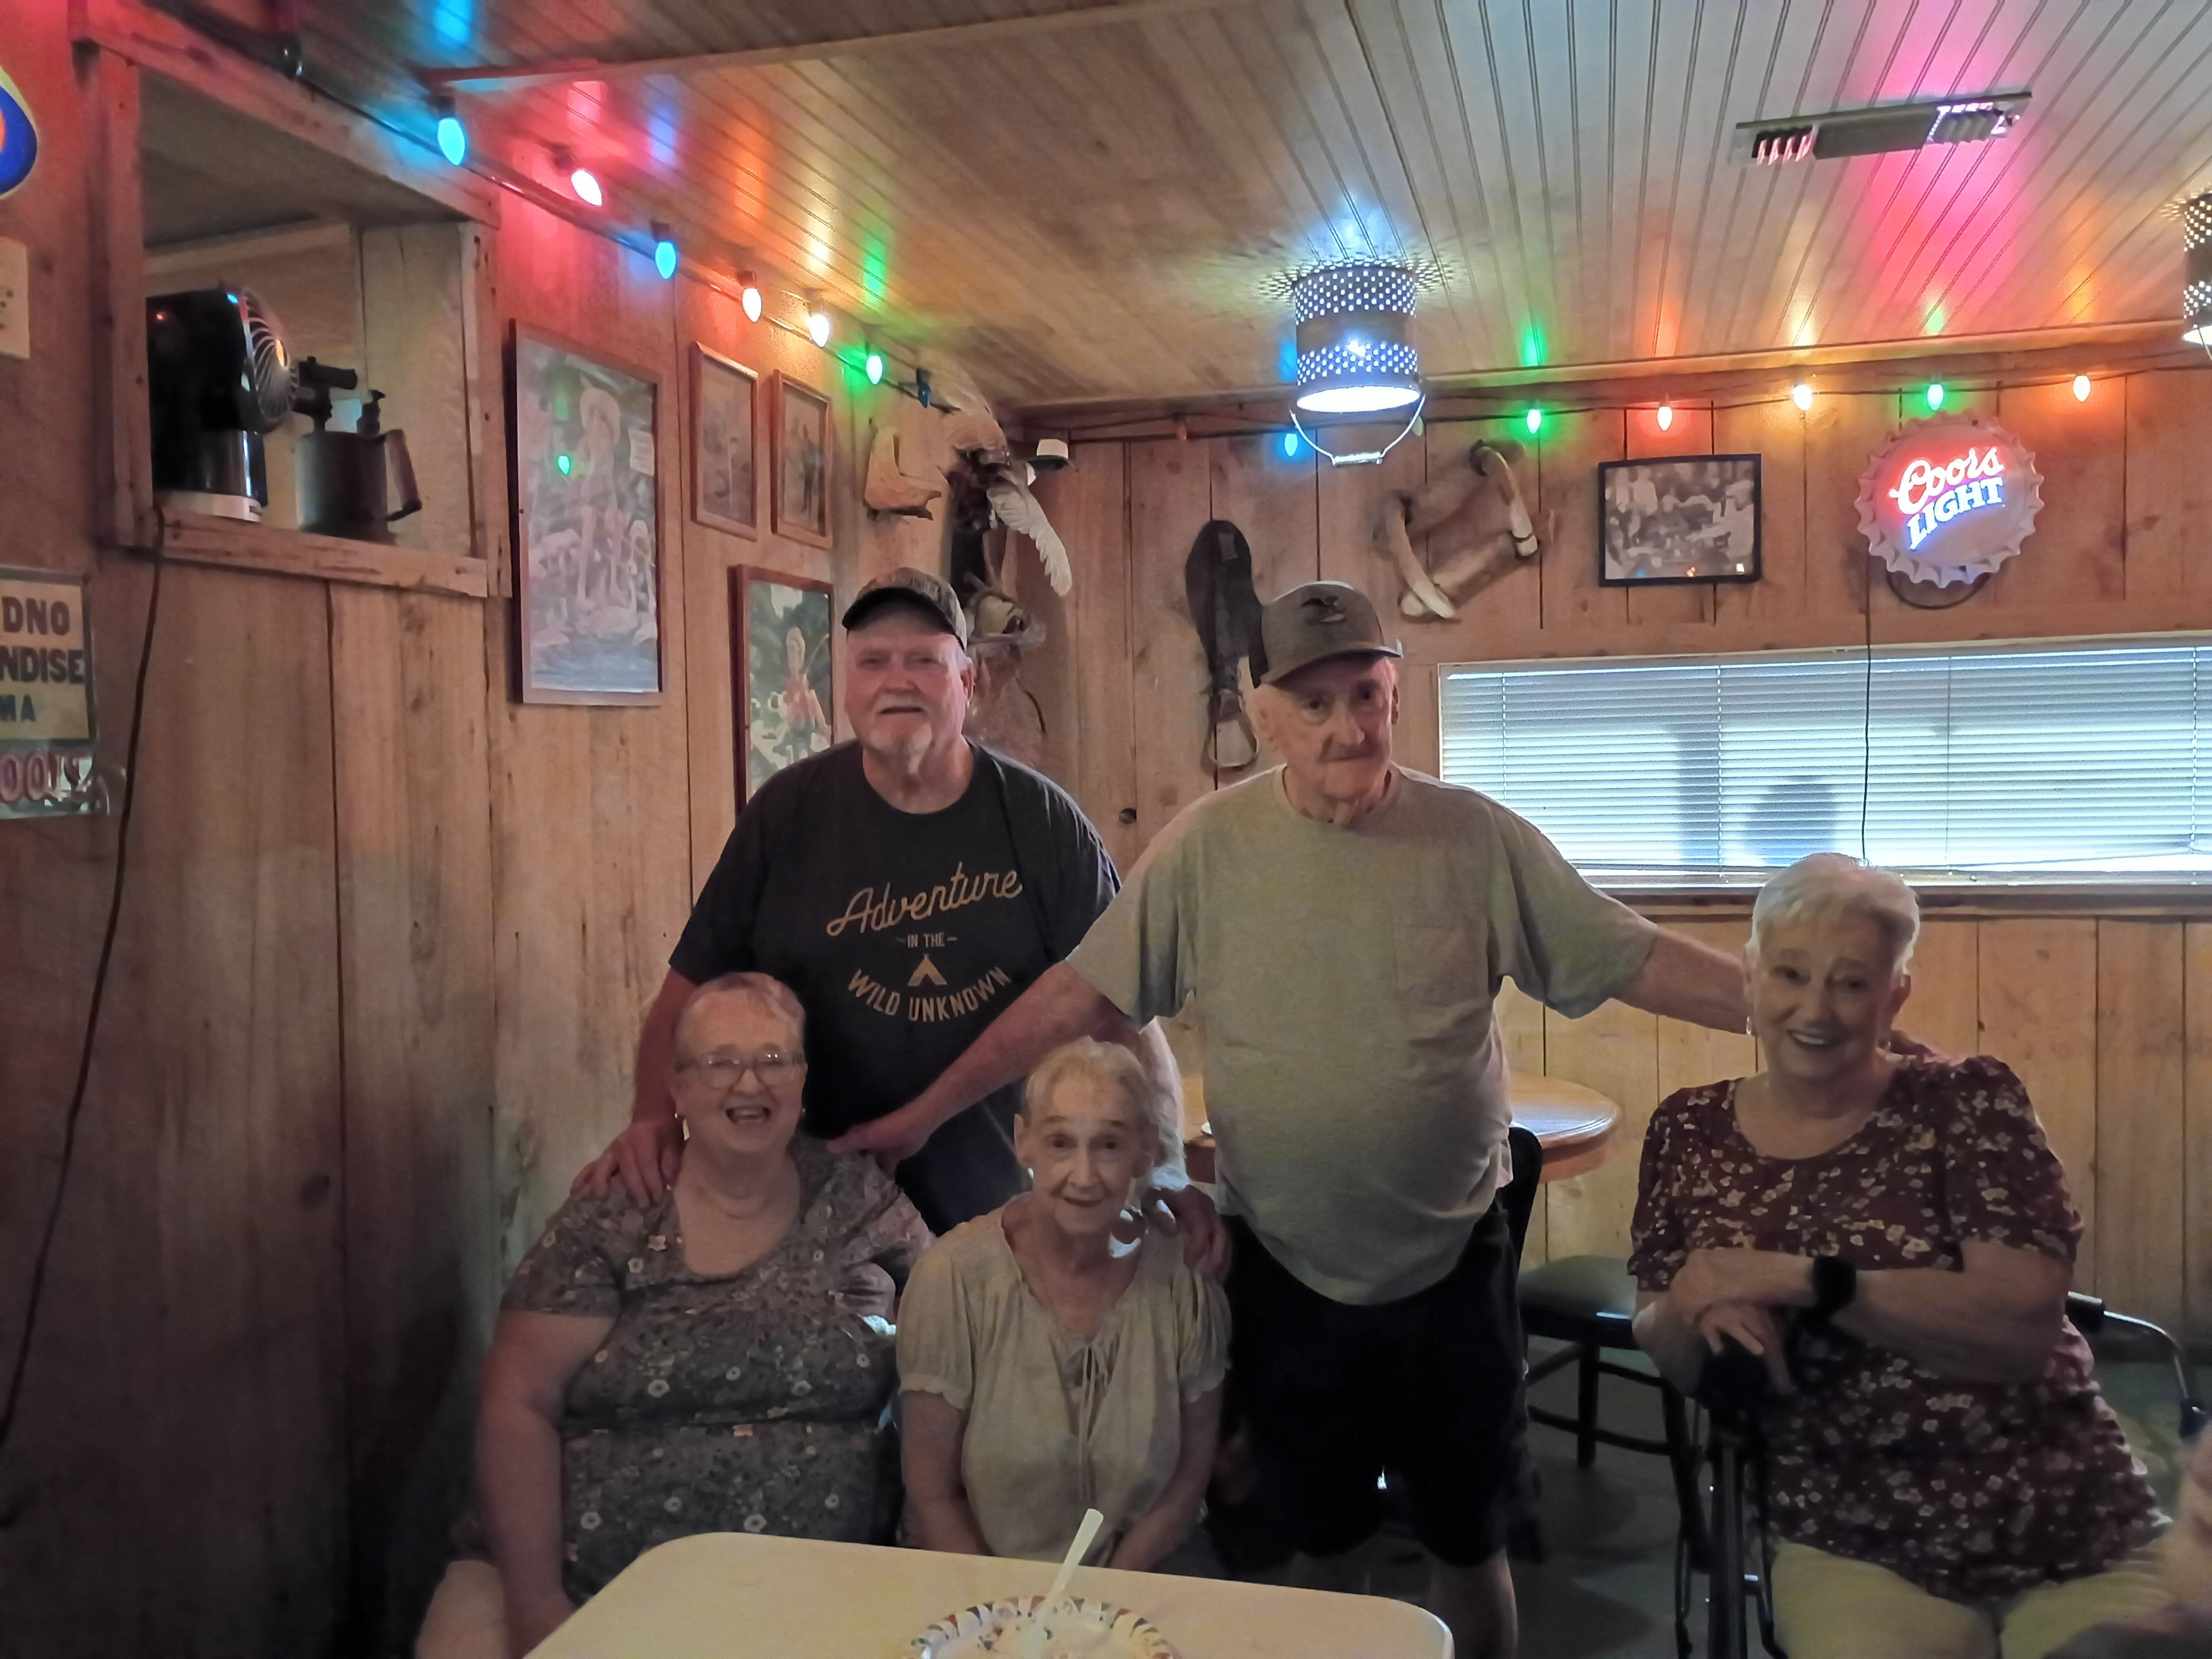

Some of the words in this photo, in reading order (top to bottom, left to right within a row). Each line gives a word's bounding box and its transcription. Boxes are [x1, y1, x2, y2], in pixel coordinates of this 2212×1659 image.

[1890, 447, 2004, 514] Coors
[1907, 477, 2004, 550] LIGHT
[2, 597, 70, 635] DNO
[0, 645, 85, 683] NDISE
[826, 861, 1024, 936] Adventure
[907, 934, 918, 948] IN
[923, 933, 945, 948] THE
[848, 969, 901, 1016] WILD
[908, 967, 1012, 1022] UNKNOWN
